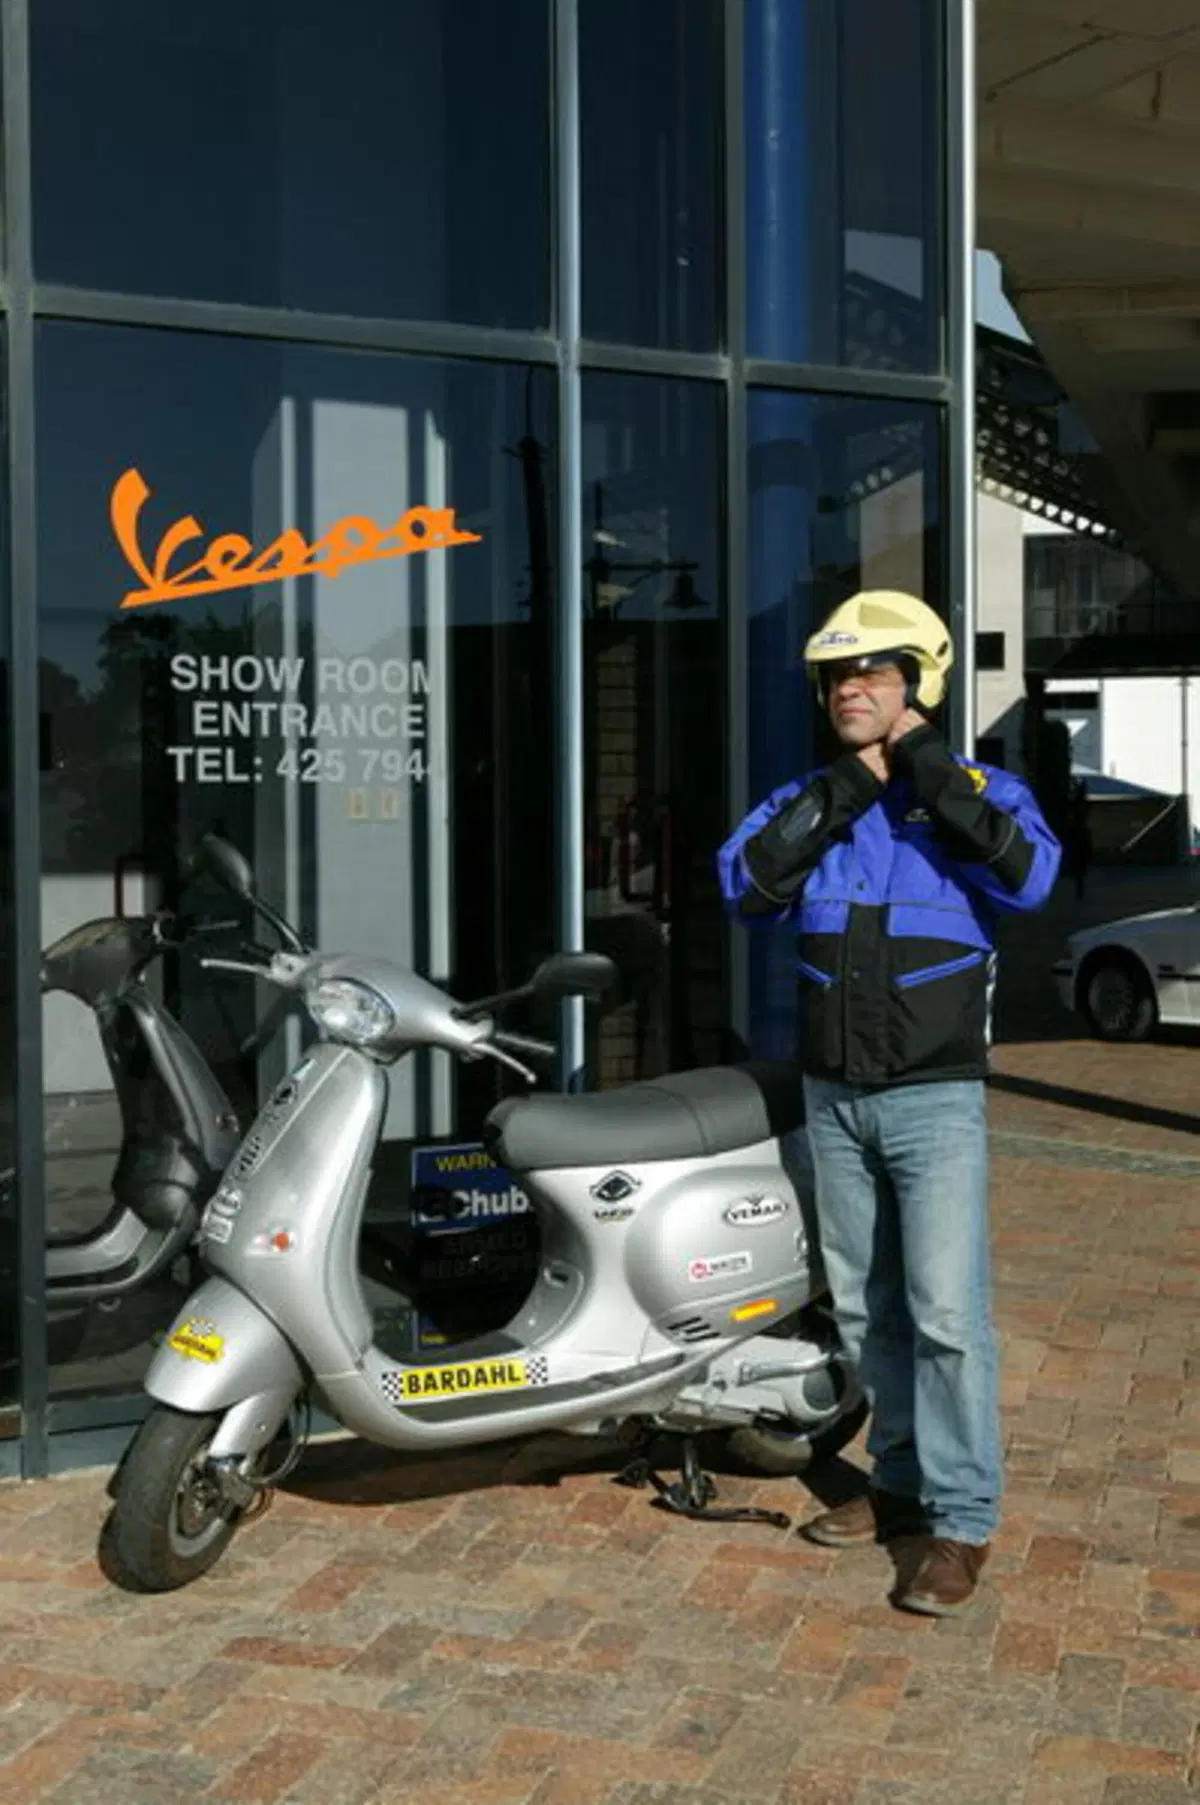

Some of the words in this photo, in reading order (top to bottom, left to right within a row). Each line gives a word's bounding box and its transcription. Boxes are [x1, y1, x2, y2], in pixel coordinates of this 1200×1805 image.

[111, 468, 482, 608] Vespa
[170, 655, 304, 692] SHOW
[193, 702, 425, 737] ENTRANCE
[166, 746, 264, 783] TEL:
[275, 749, 346, 783] 425
[358, 749, 430, 782] 794
[407, 1364, 521, 1394] BARDAHL
